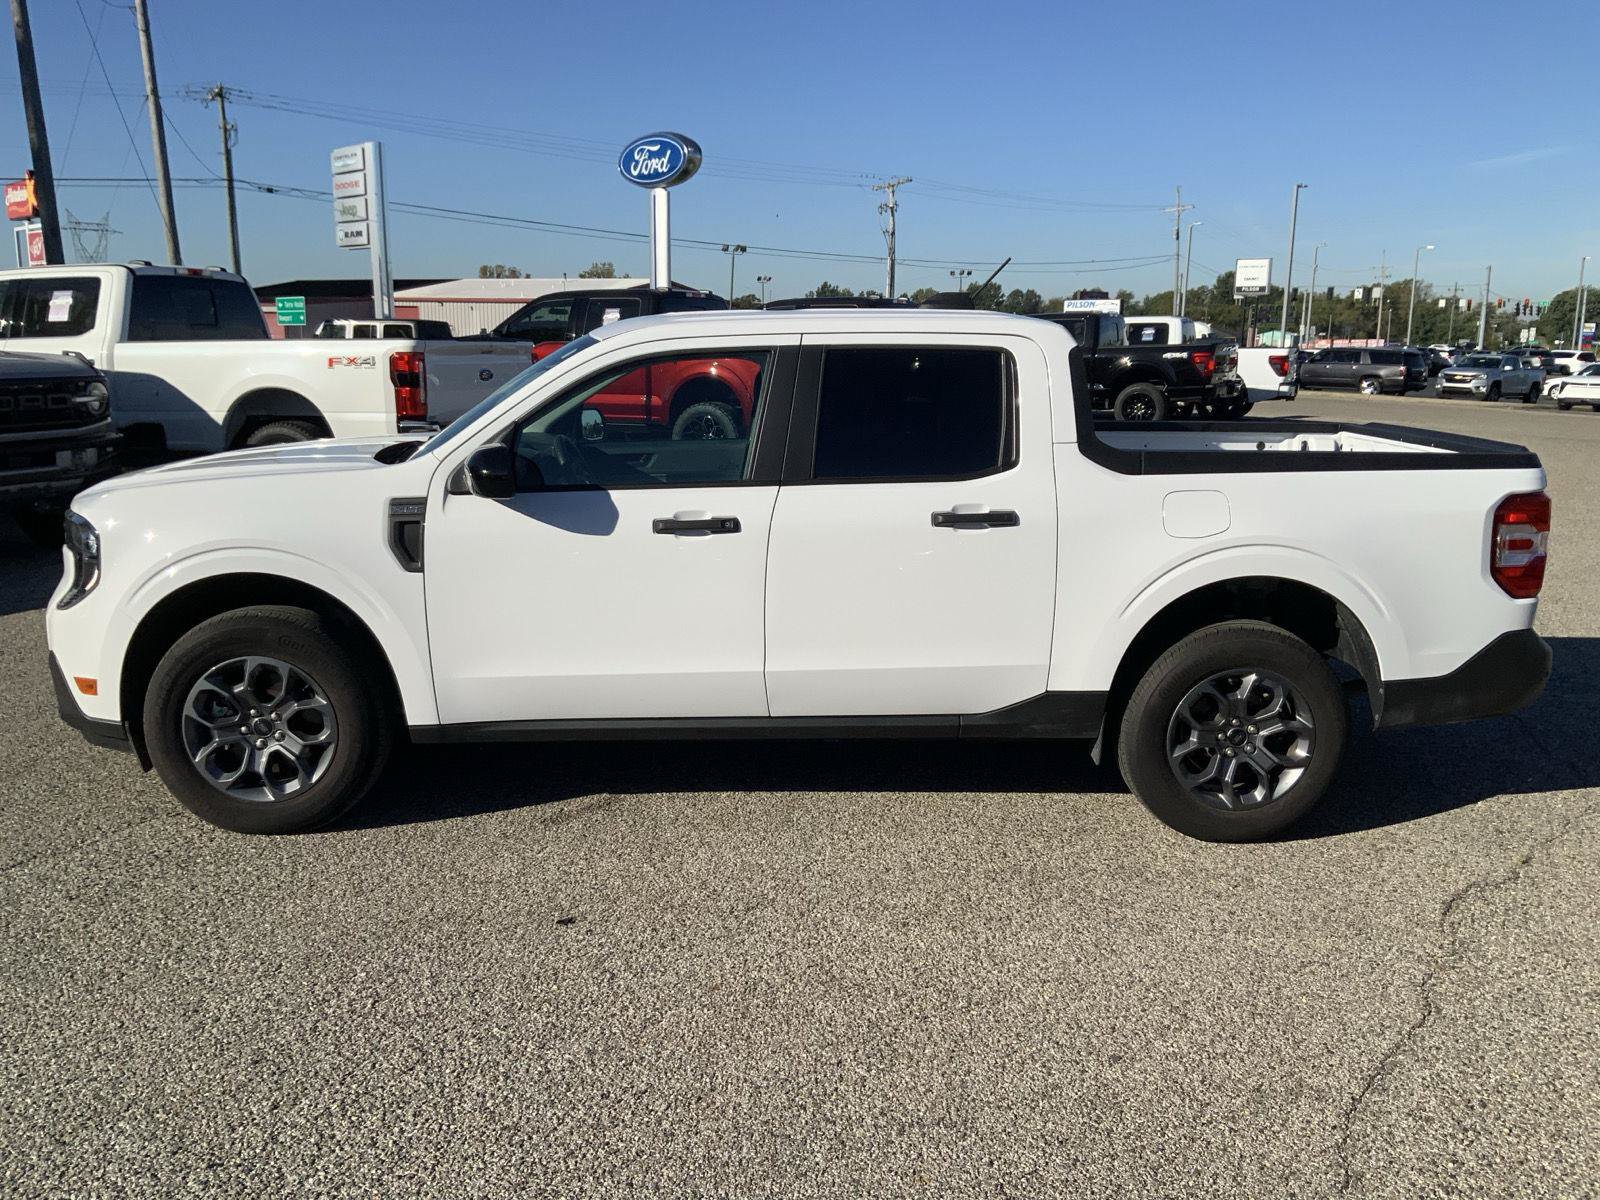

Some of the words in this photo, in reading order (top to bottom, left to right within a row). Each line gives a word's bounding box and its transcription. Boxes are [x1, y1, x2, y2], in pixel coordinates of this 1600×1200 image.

[630, 144, 671, 177] Ford
[335, 180, 360, 190] DODGE
[340, 203, 357, 218] Jeep
[344, 231, 363, 239] RAM
[1066, 301, 1095, 309] PILSON
[327, 356, 376, 368] FX4
